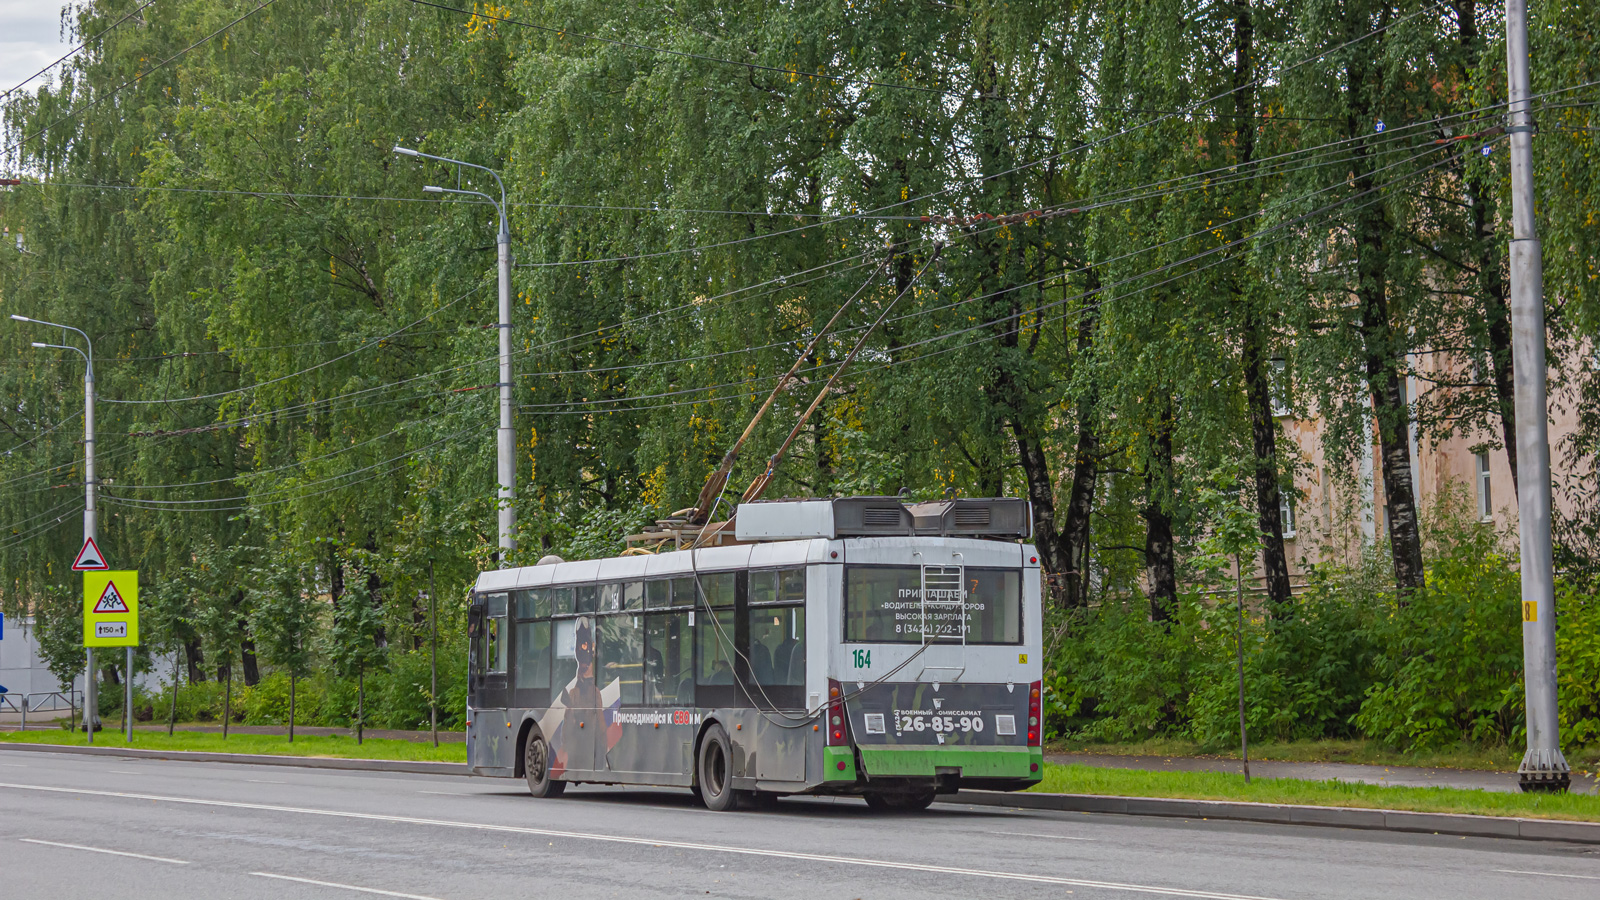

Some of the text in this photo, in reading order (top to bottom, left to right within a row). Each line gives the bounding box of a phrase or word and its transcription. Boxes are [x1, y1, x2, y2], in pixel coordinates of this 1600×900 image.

[970, 579, 979, 594] 7
[930, 602, 985, 611] КОНДУКОРОВ
[934, 613, 972, 621] ЗАРПЛАТА
[895, 625, 902, 633] 8
[904, 624, 933, 634] (3424)
[852, 649, 871, 668] 164
[612, 710, 666, 726] Присоединяйся
[901, 716, 984, 732] 26-85-90
